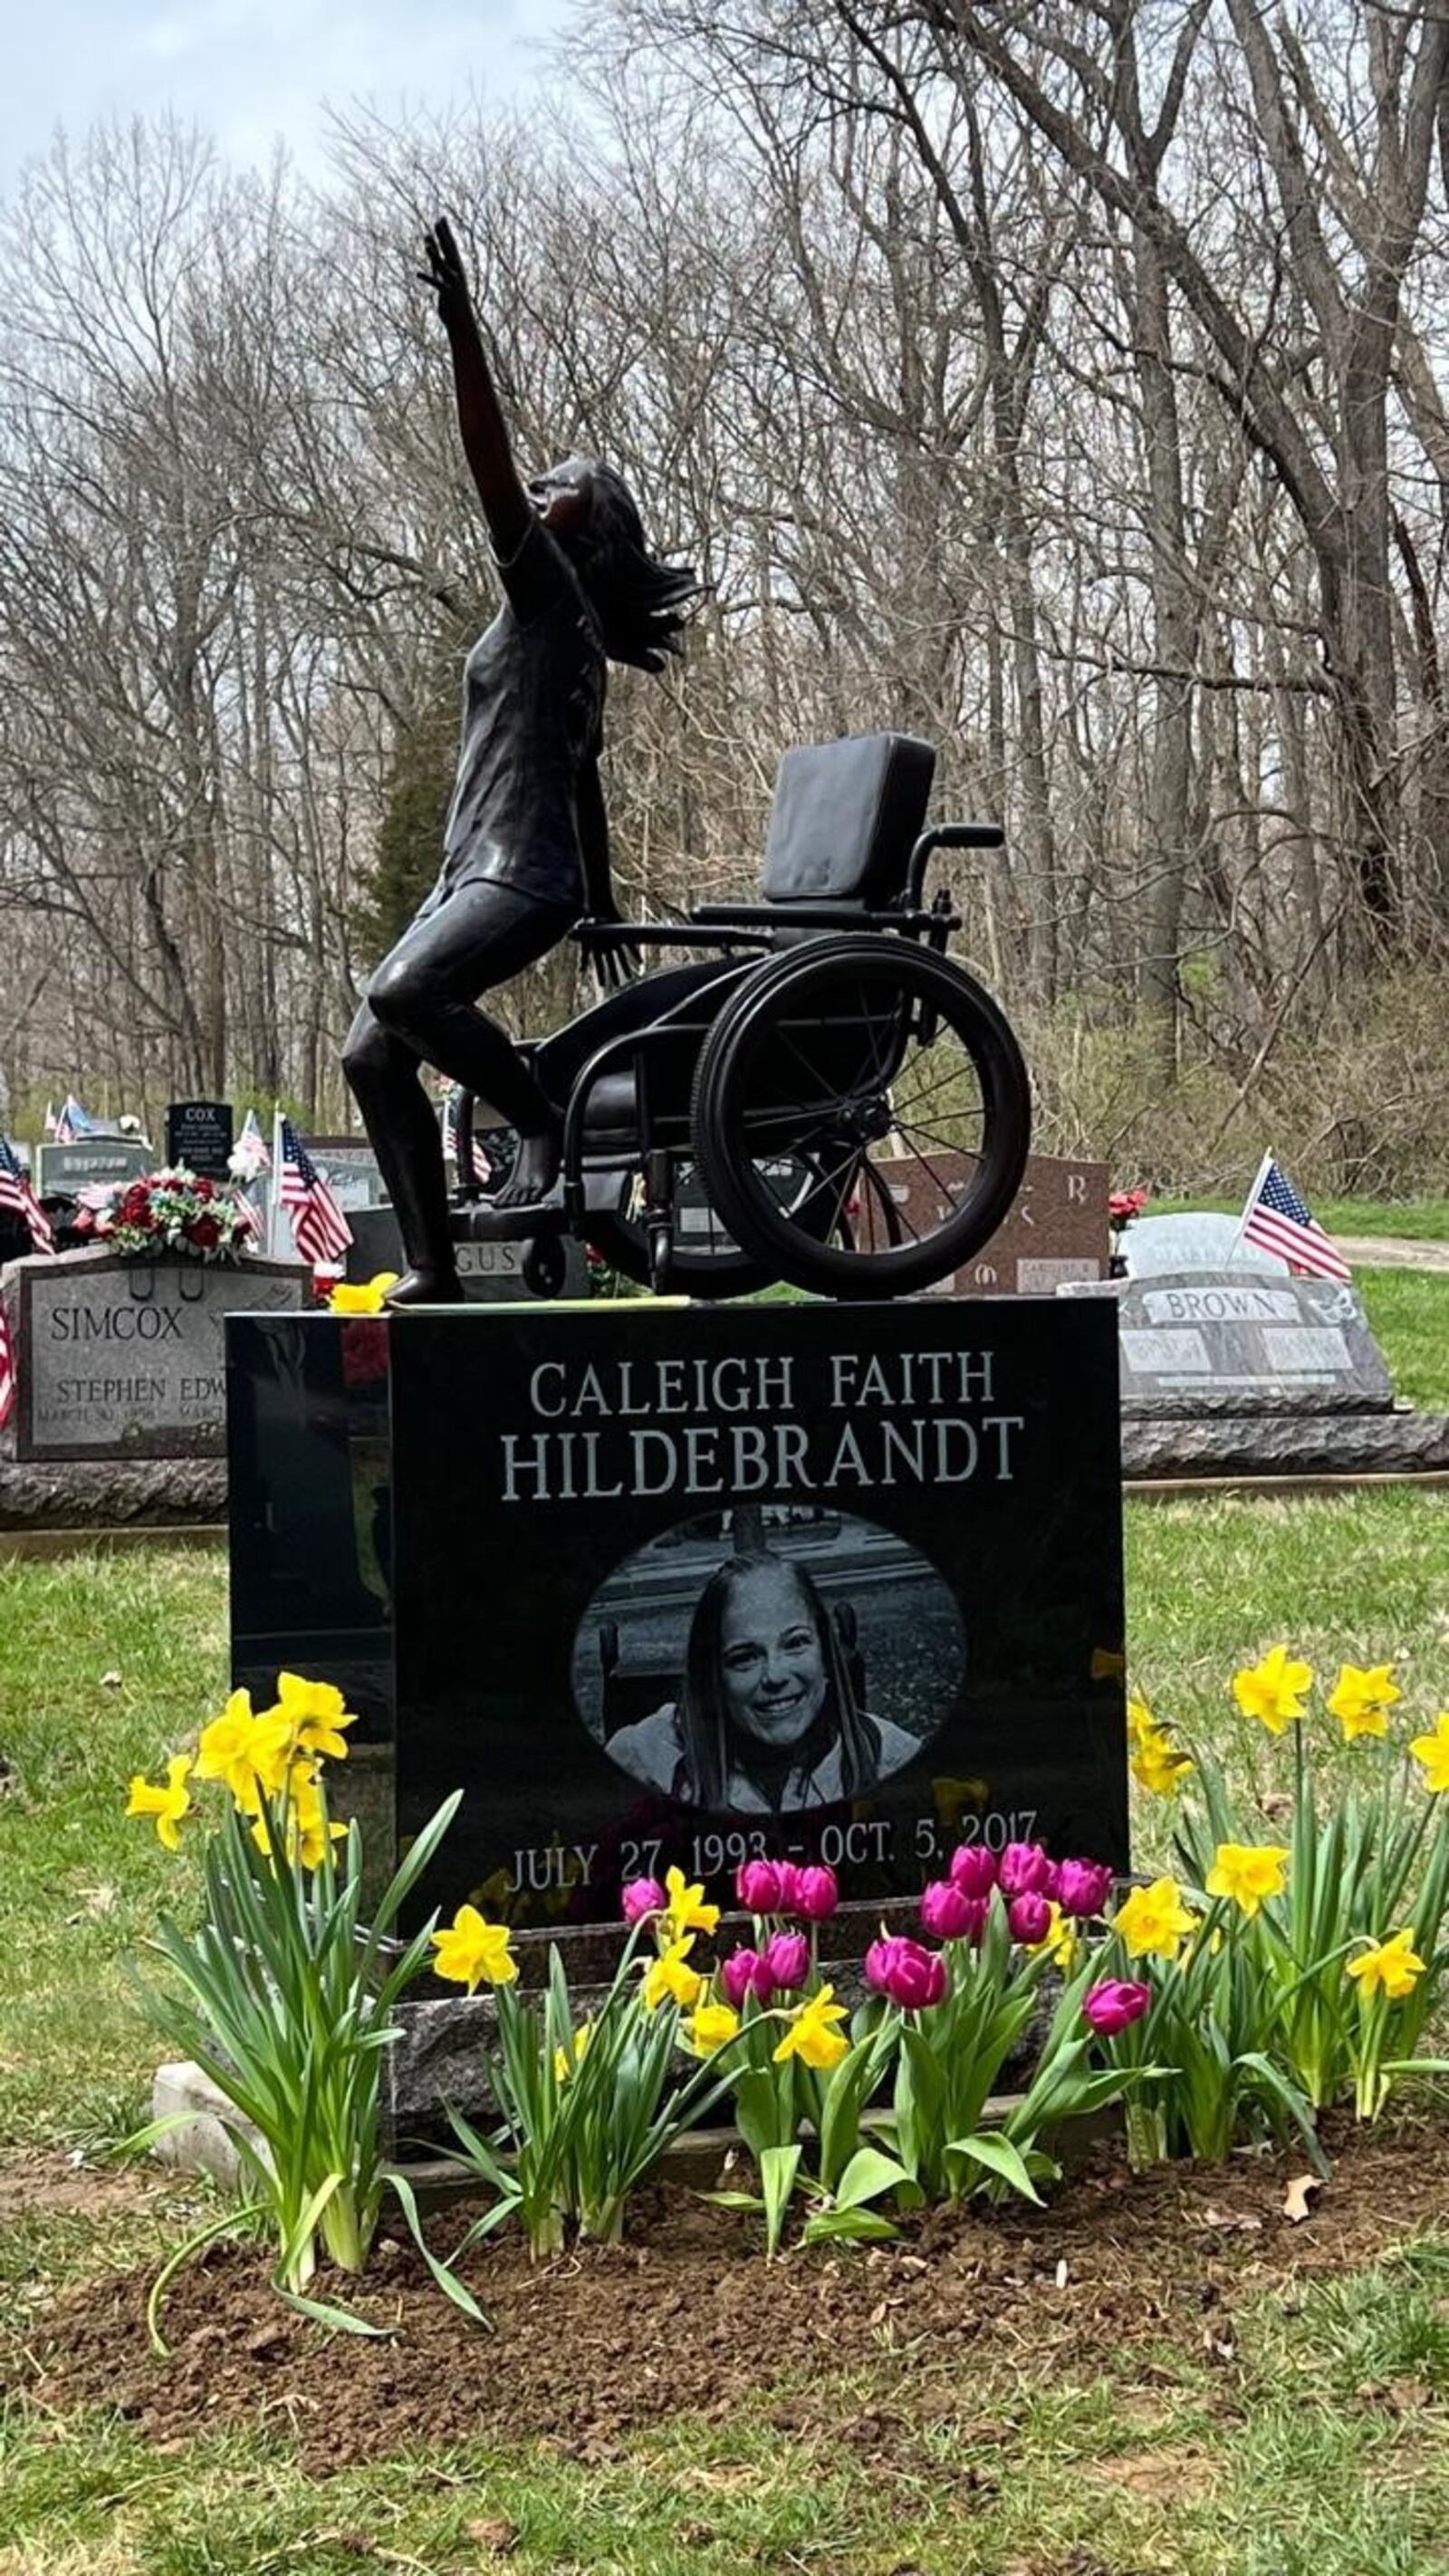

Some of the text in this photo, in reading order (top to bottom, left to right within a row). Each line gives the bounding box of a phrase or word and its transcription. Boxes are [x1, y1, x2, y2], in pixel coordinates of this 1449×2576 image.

[186, 1108, 215, 1122] COX
[1166, 1293, 1281, 1319] BROWN
[51, 1307, 183, 1341] SIMCOX
[57, 1378, 166, 1403] STEPHEN
[530, 1350, 995, 1417] CALEIGH FAITH
[500, 1417, 1024, 1500] HILDEBRANDT
[504, 1844, 599, 1892] JULY
[620, 1840, 663, 1881] 27
[693, 1831, 769, 1877] 1993
[820, 1821, 895, 1867] OCT.
[915, 1818, 944, 1860] 5,
[963, 1811, 1037, 1853] 2017
